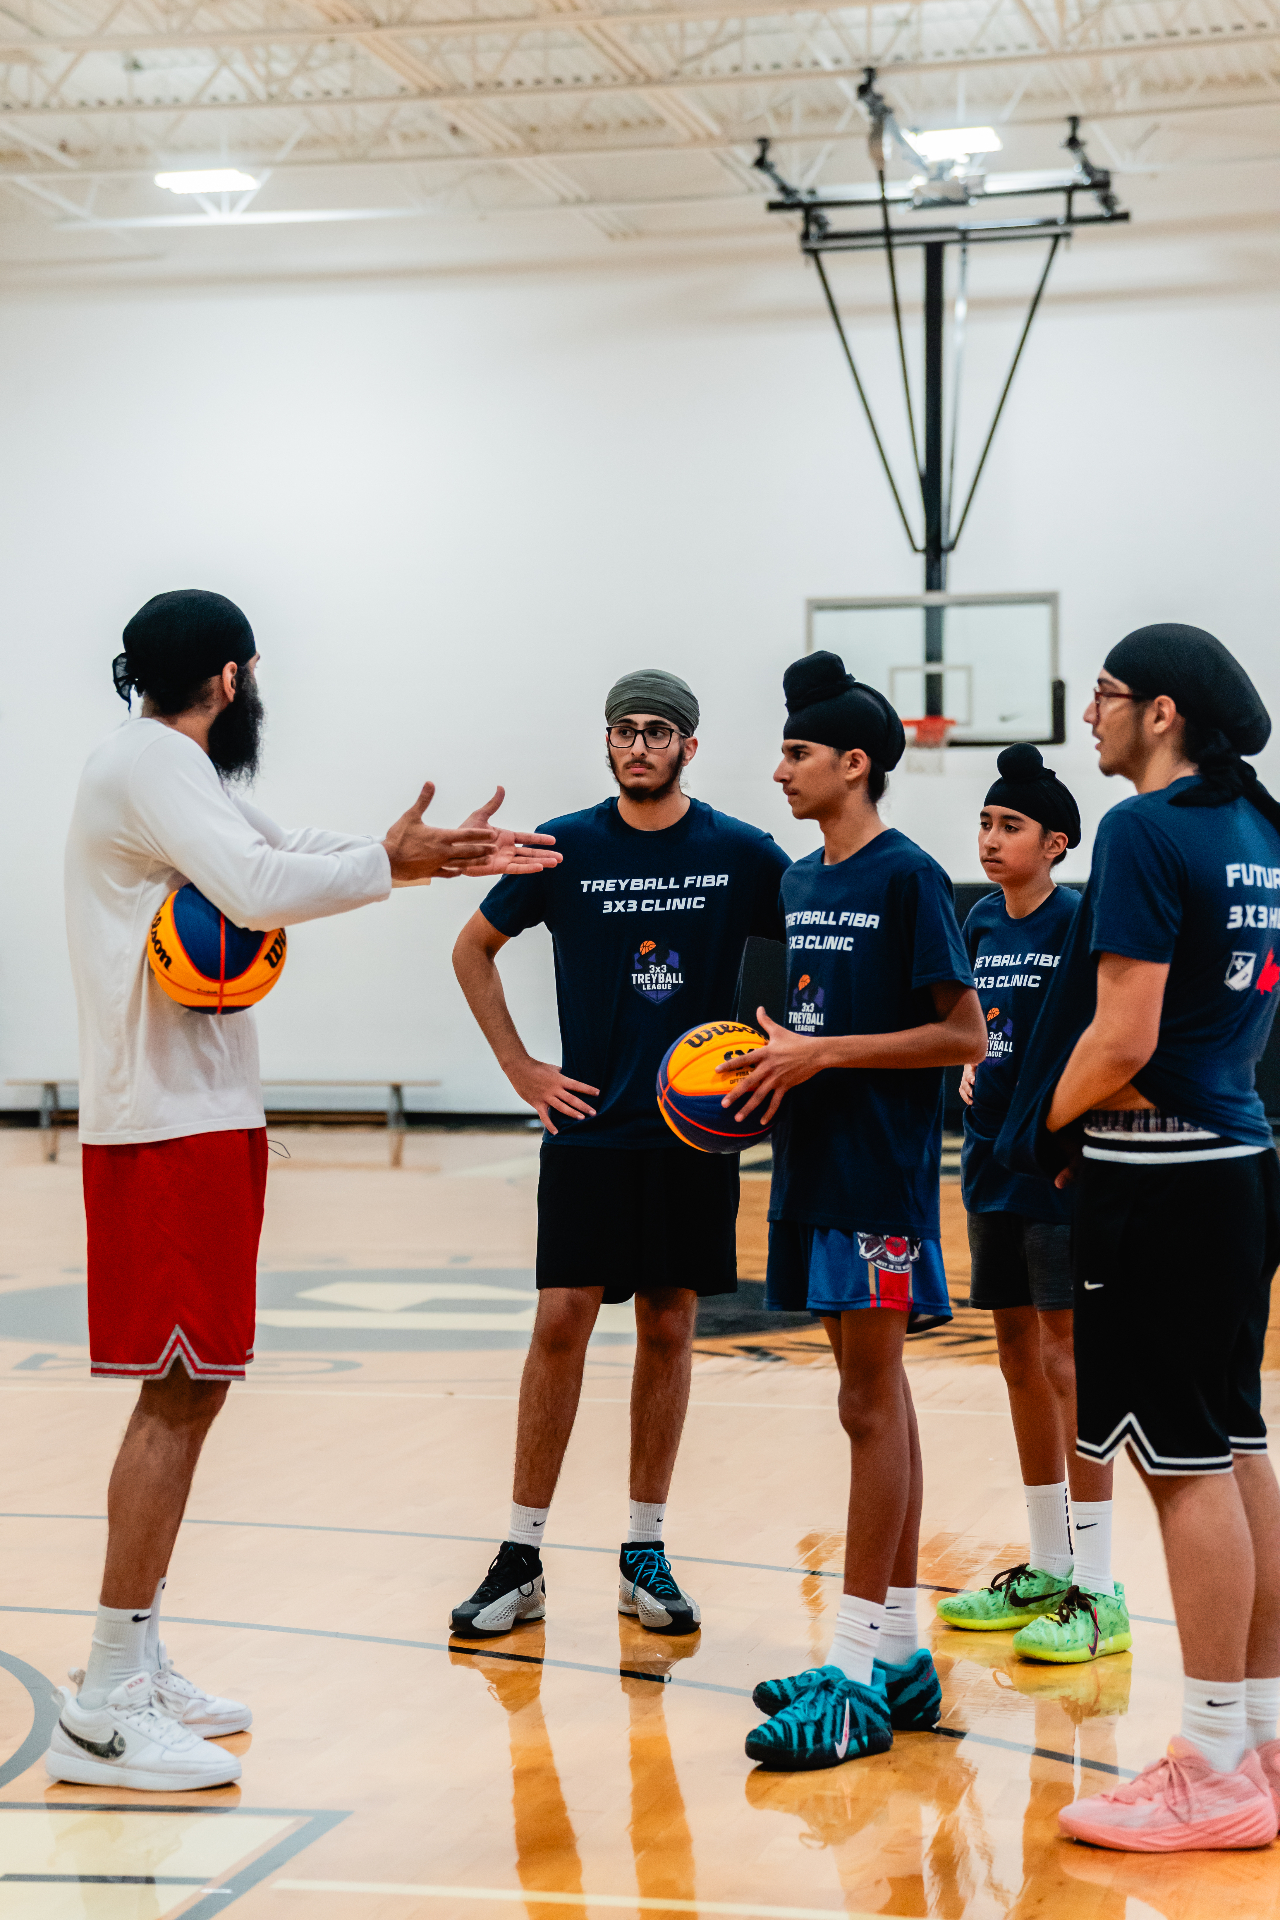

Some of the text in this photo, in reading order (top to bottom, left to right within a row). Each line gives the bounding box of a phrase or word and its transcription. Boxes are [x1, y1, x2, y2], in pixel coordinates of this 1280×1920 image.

[580, 874, 729, 892] TREYBALL FIBA
[602, 897, 705, 913] 3X3 CLINIC
[839, 912, 880, 929] FIBA
[805, 935, 854, 951] CLINIC
[649, 965, 667, 973] 3x3
[631, 973, 684, 984] TREYBALL
[996, 974, 1041, 988] CLINIC
[801, 1002, 815, 1013] 3x3
[788, 1012, 824, 1026] TREYBALL
[988, 1032, 1003, 1041] 3x3
